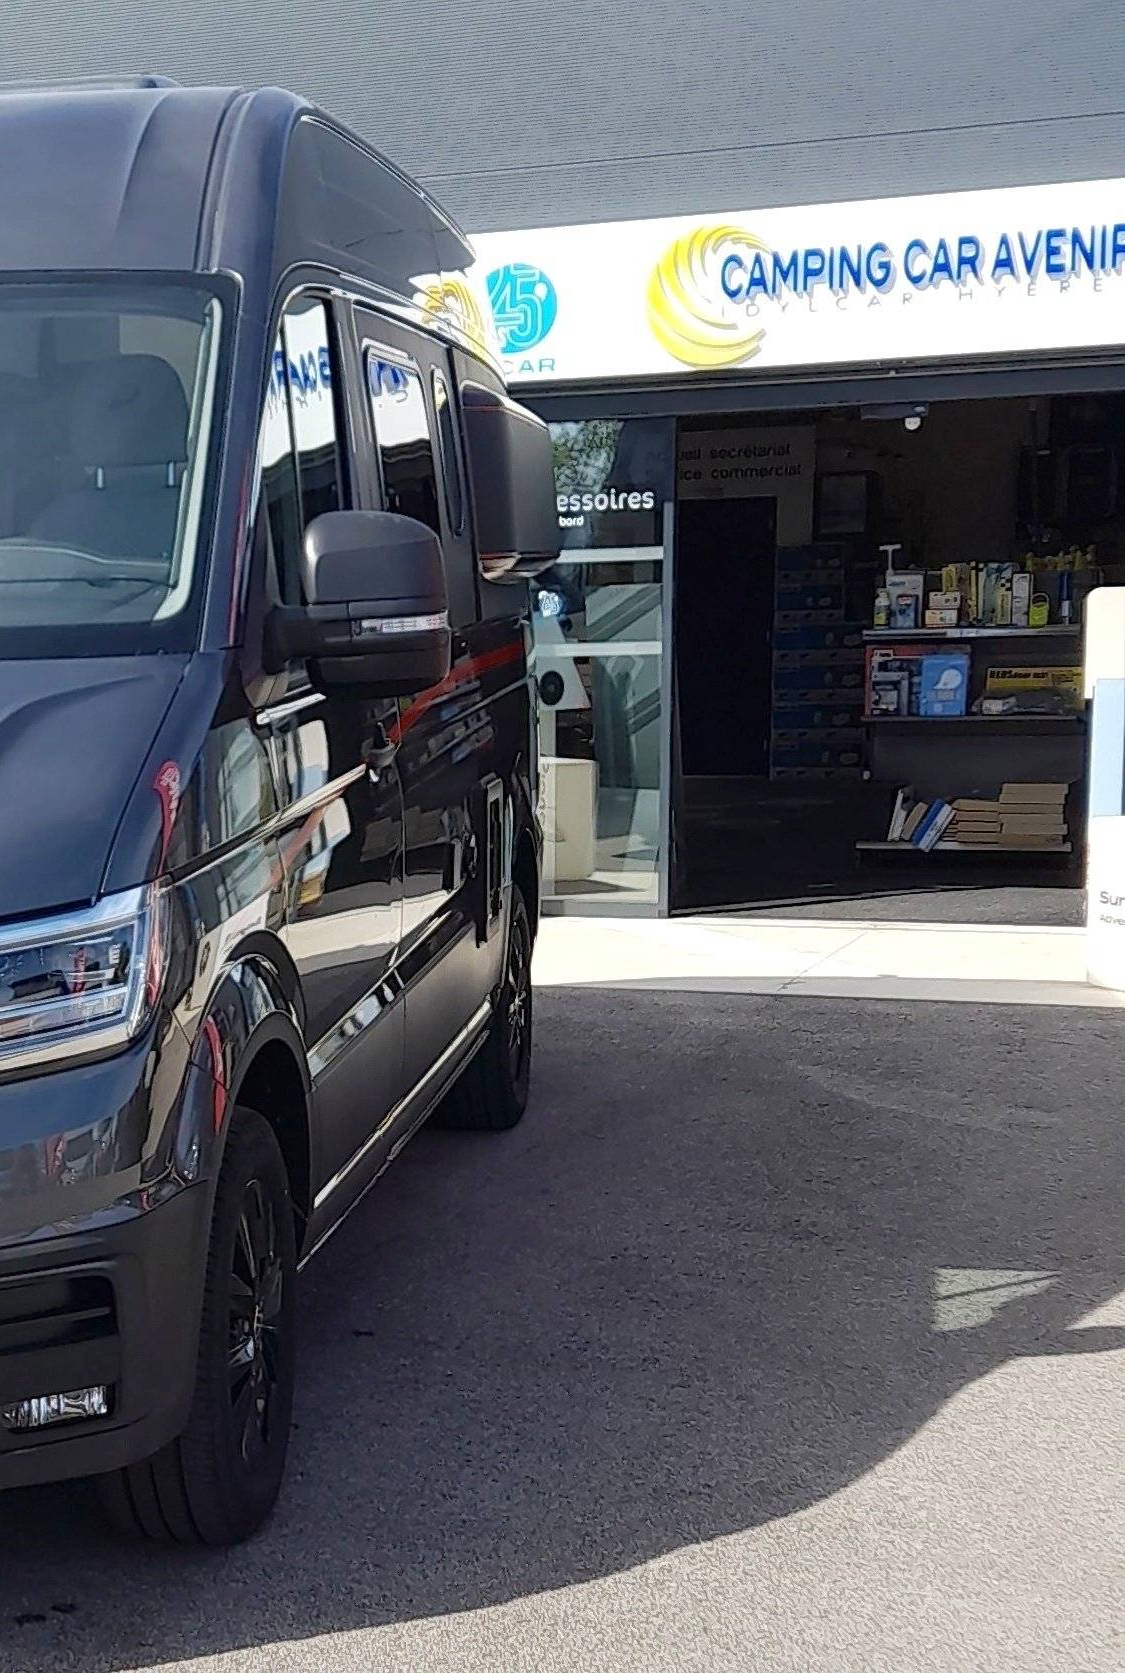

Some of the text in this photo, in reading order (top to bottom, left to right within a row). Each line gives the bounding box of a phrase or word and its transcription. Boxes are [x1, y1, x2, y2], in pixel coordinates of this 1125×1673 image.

[721, 242, 896, 303] CAMPING
[904, 236, 984, 290] CAR
[557, 488, 654, 511] essoires
[559, 515, 584, 527] bord
